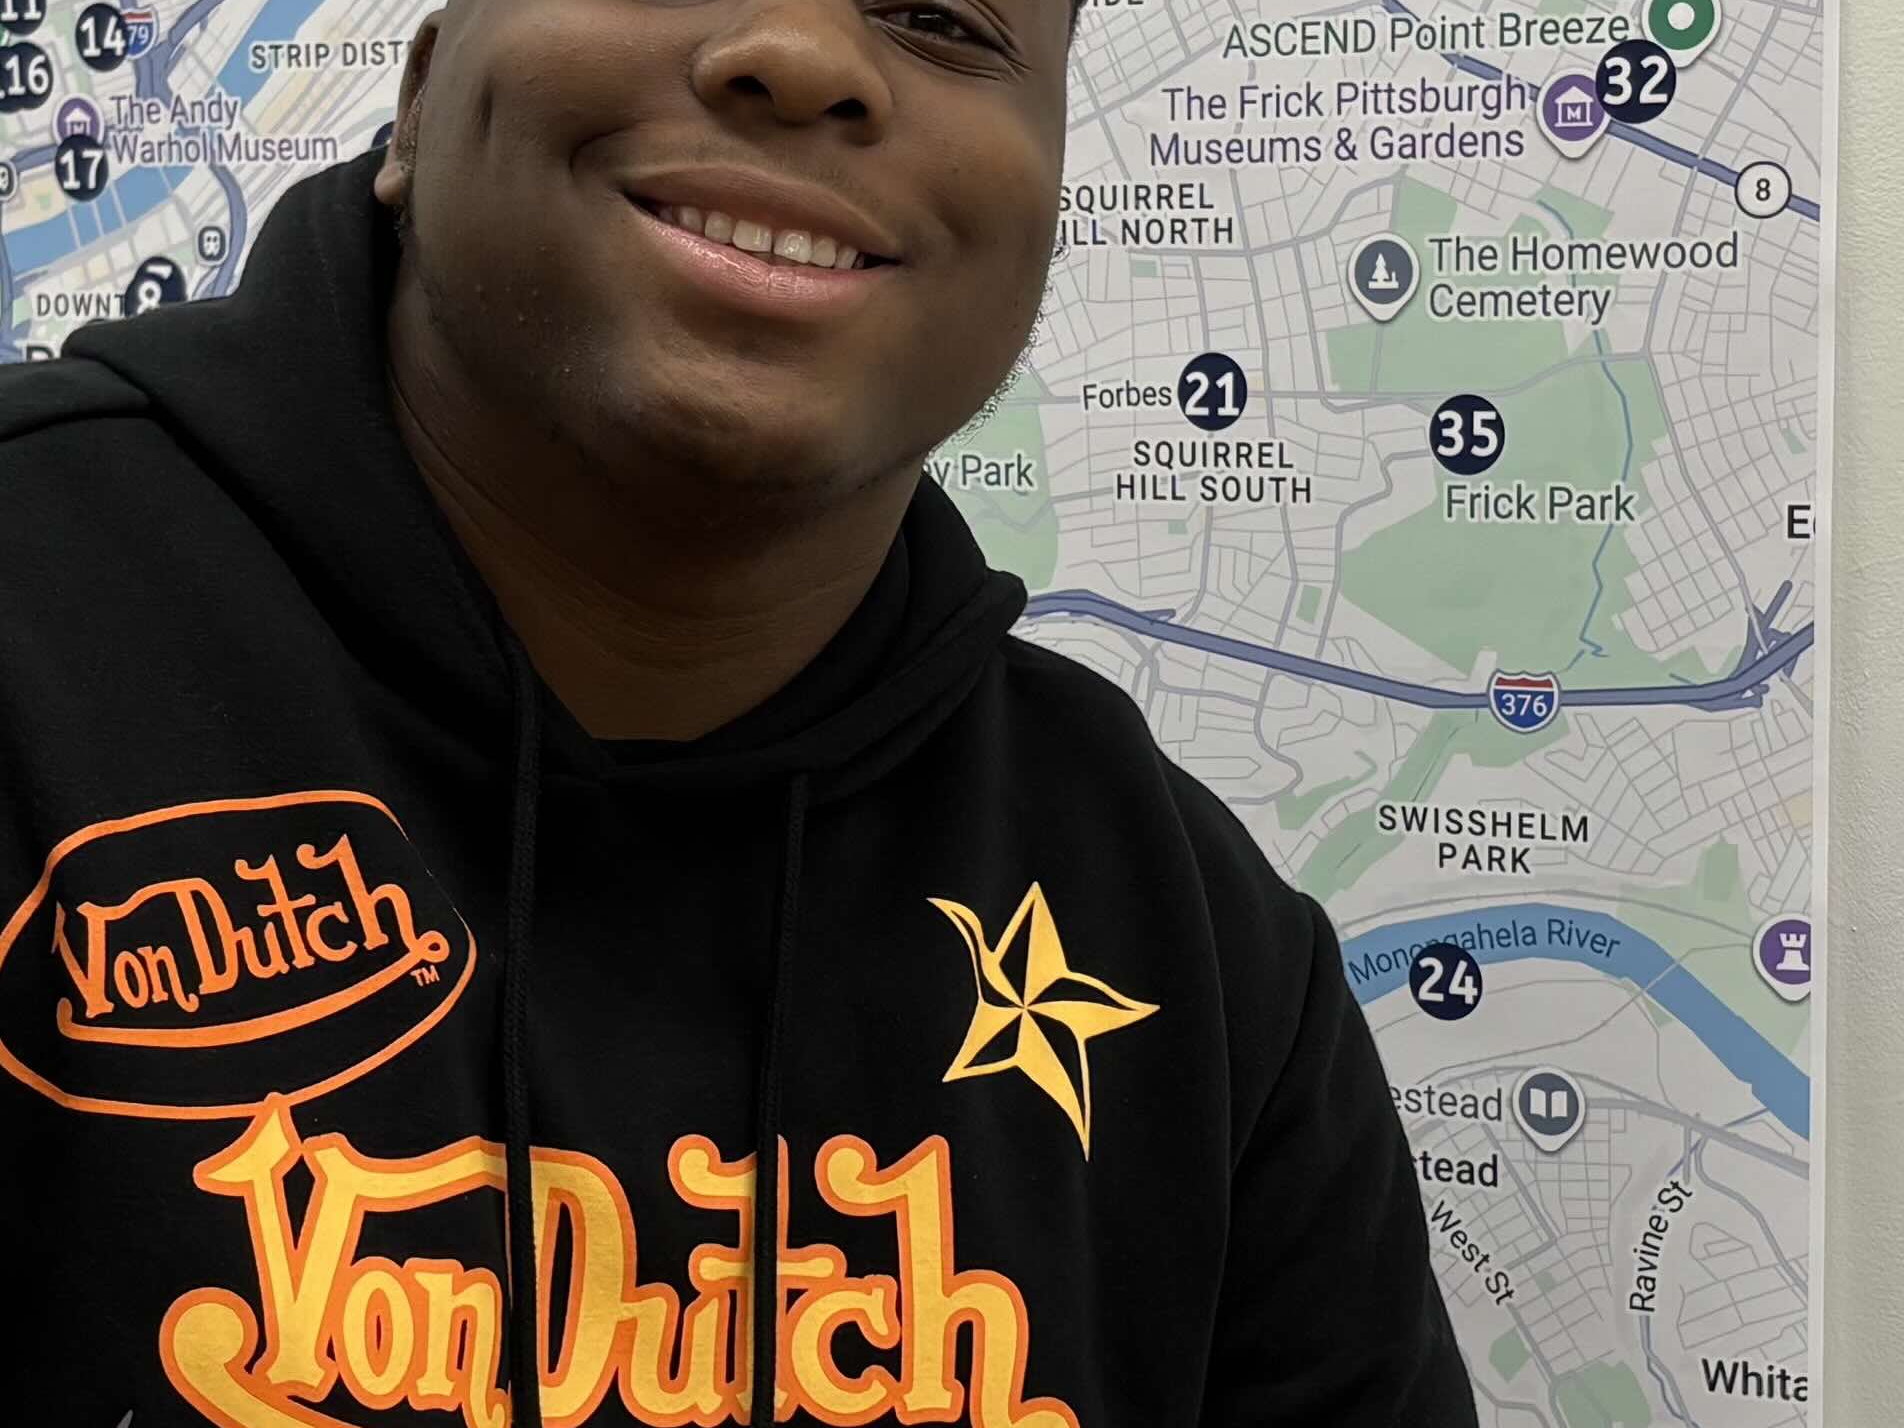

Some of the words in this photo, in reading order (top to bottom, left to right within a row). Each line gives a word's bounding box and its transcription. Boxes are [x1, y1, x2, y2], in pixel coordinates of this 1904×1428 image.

[251, 43, 329, 69] STRIP
[1223, 19, 1376, 59] ASCEND
[1391, 15, 1485, 52] Point
[1499, 14, 1630, 47] Breeze
[1162, 87, 1226, 122] The
[1241, 82, 1322, 119] Frick
[1337, 77, 1526, 120] Pittsburgh
[1603, 56, 1669, 105] 32
[111, 96, 164, 127] The
[171, 93, 238, 129] Andy
[113, 132, 210, 165] Warhol
[219, 131, 339, 162] Museum
[1150, 132, 1321, 166] Museums
[1335, 127, 1357, 160] &
[1370, 123, 1524, 160] Gardens
[1060, 183, 1214, 213] SQUIRREL
[1121, 217, 1234, 246] NORTH
[1430, 238, 1498, 271] The
[1511, 232, 1738, 270] Homewood
[1430, 283, 1611, 325] Cemetery
[1083, 379, 1172, 411] Forbes
[1184, 373, 1240, 416] 21
[1436, 410, 1498, 457] 35
[1133, 441, 1294, 469] SQUIRREL
[1116, 475, 1186, 502] HILL
[1201, 476, 1312, 505] SOUTH
[1446, 485, 1534, 521] Frick
[1548, 487, 1636, 522] Park
[1501, 695, 1547, 717] 376
[1379, 804, 1589, 843] SWISSHELM
[1438, 843, 1531, 874] PARK
[51, 882, 199, 1019] Von
[176, 834, 452, 994] Dutch
[1416, 957, 1478, 1005] 24
[1431, 1200, 1490, 1274] West
[1484, 1272, 1515, 1306] St
[1630, 1213, 1669, 1313] Ravine
[1659, 1180, 1693, 1212] St
